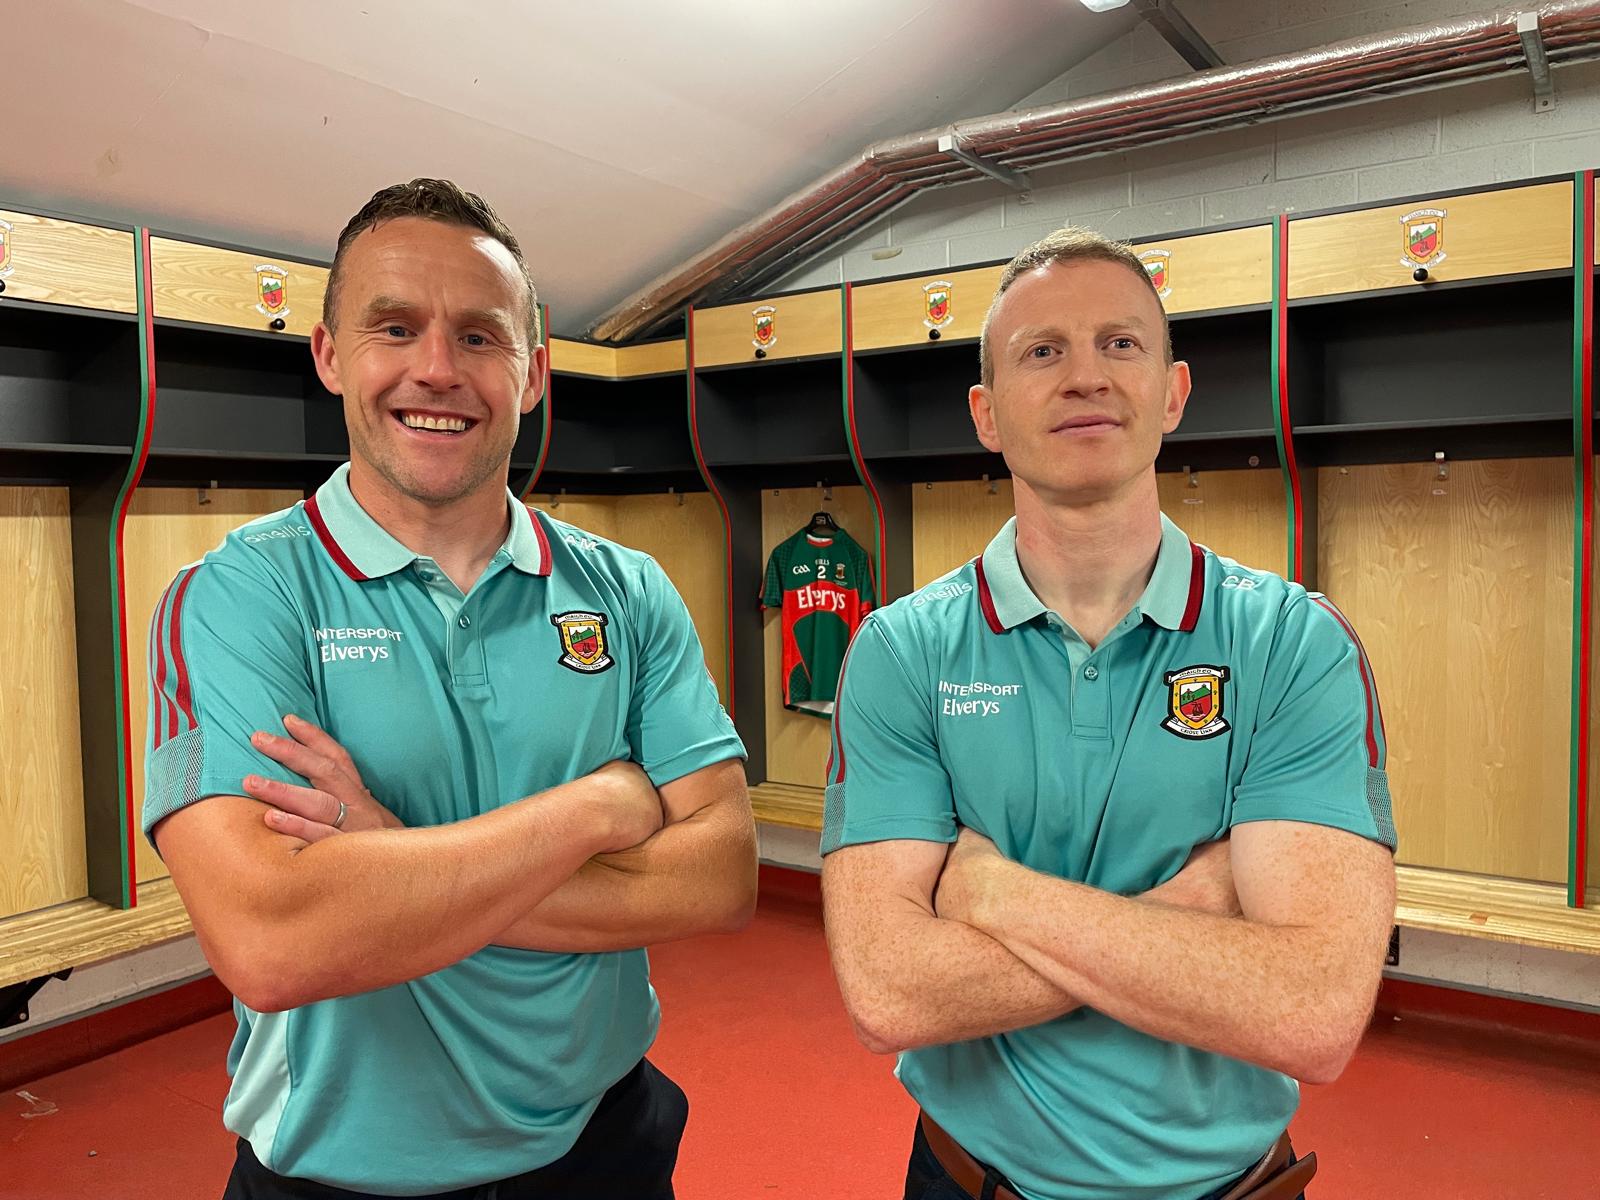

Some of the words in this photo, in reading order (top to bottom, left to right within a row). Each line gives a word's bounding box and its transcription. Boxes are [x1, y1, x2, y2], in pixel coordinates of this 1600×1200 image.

[817, 565, 827, 579] 2
[1221, 575, 1256, 590] CB
[320, 642, 389, 663] Elverys
[942, 698, 1001, 717] Elverys
